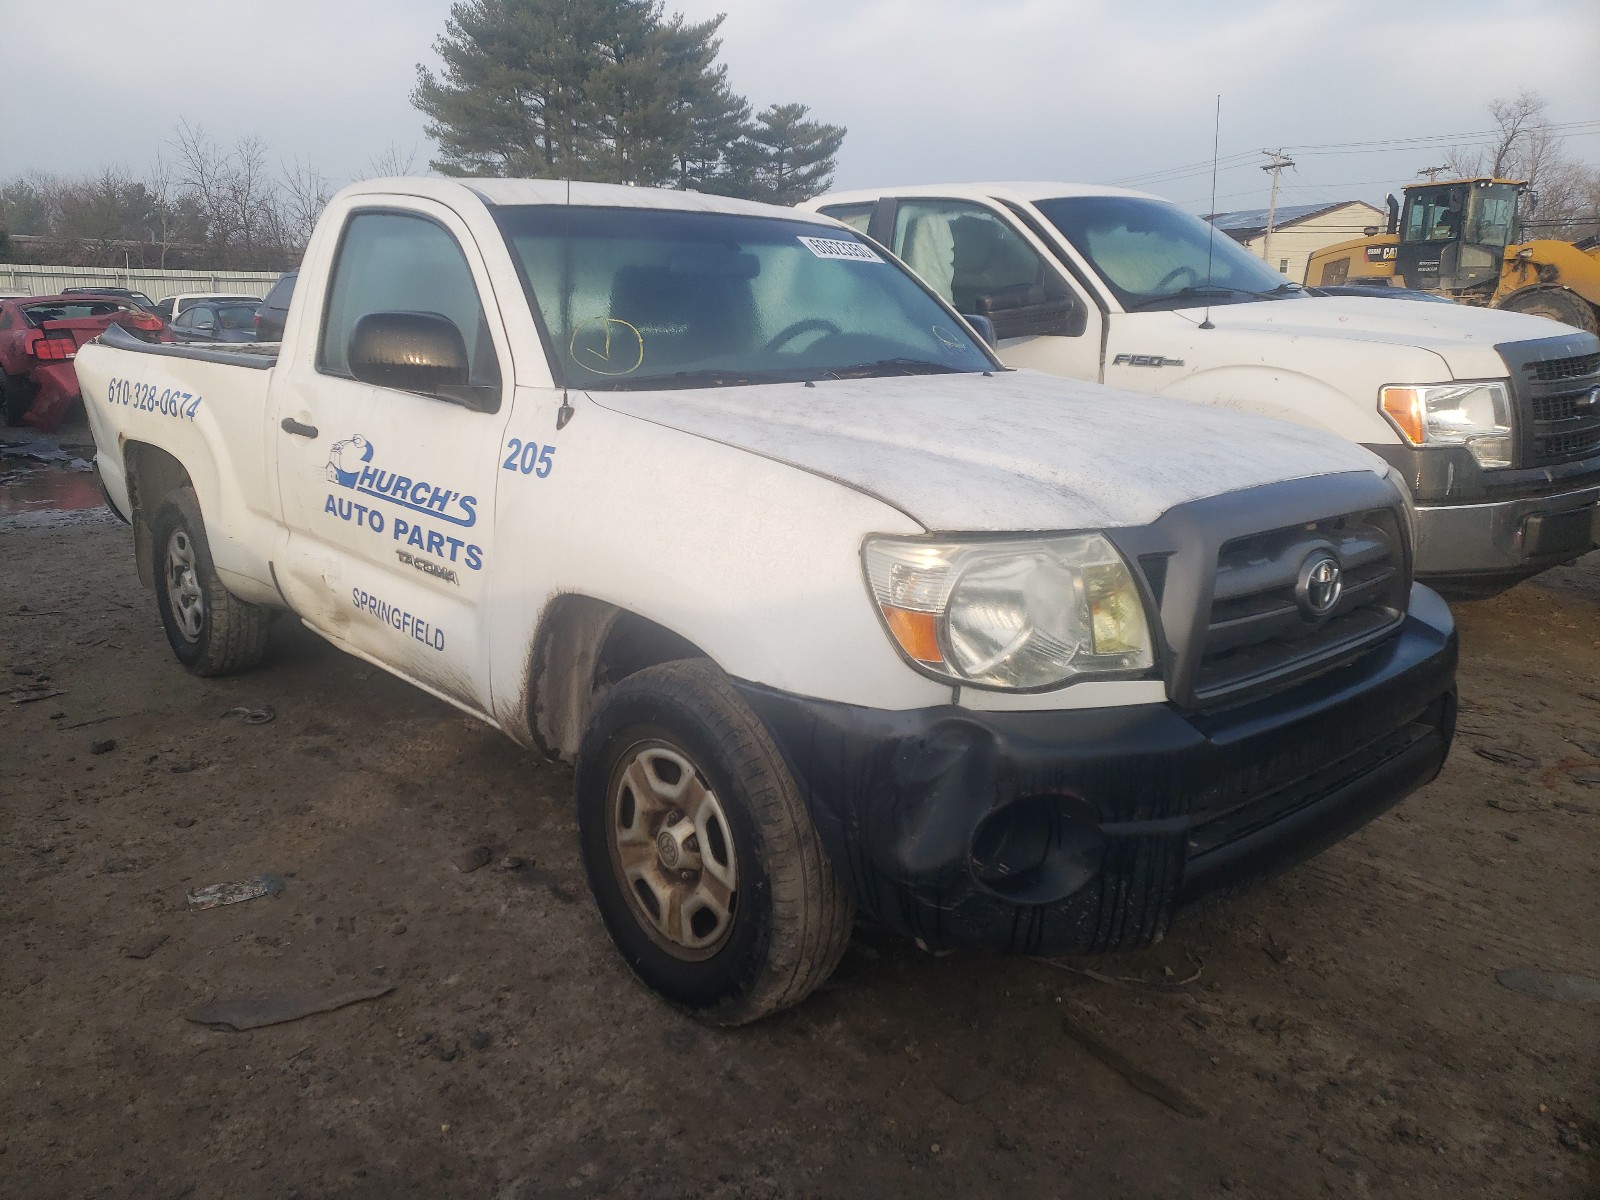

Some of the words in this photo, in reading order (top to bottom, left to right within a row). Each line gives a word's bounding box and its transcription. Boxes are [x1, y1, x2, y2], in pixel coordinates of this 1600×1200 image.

[502, 438, 556, 479] 205
[324, 494, 385, 533] AUTO
[393, 518, 484, 571] PARTS
[396, 549, 460, 586] TACOMA
[352, 587, 445, 651] SPRINGFIELD
